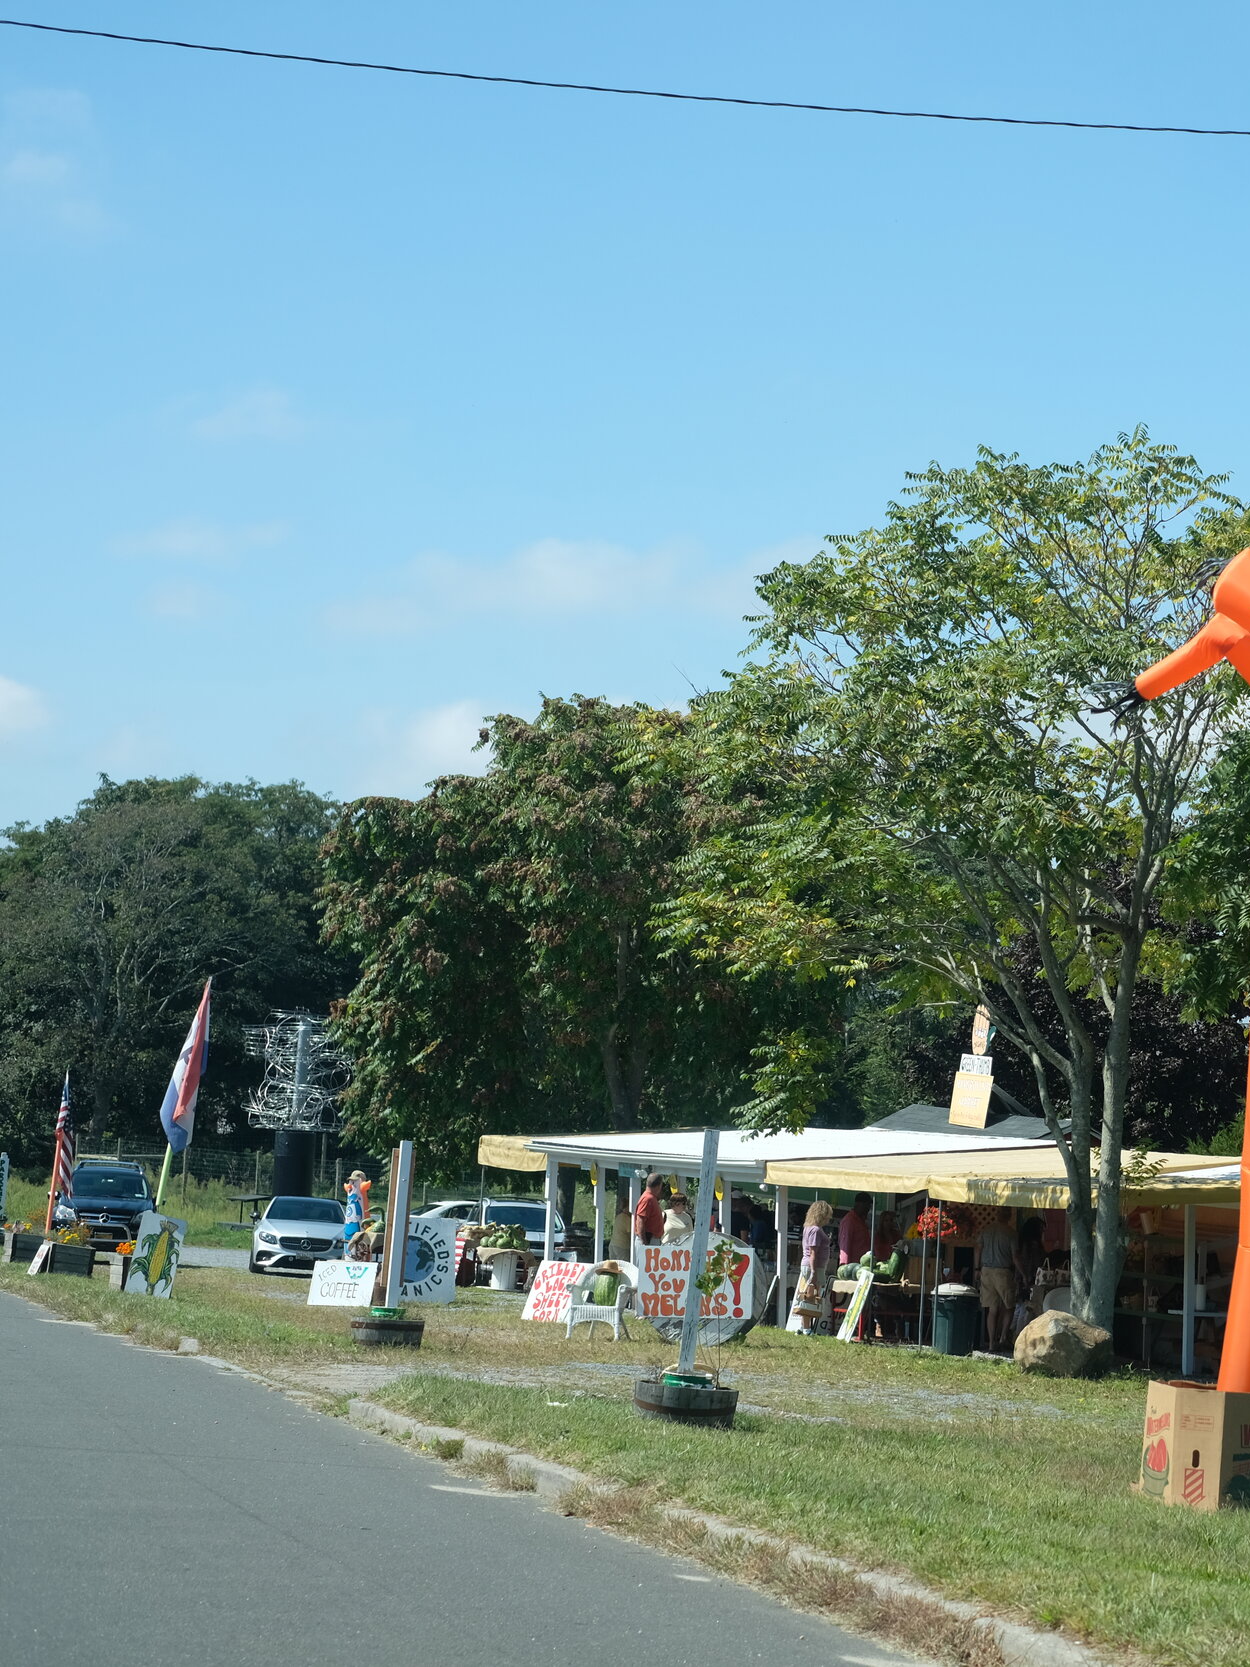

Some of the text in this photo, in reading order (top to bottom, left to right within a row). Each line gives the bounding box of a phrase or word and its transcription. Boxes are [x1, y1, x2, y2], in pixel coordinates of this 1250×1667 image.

[318, 1264, 337, 1282] ICED
[401, 1263, 449, 1297] ANICS
[320, 1281, 360, 1299] COFFEE
[640, 1291, 729, 1317] MELNS
